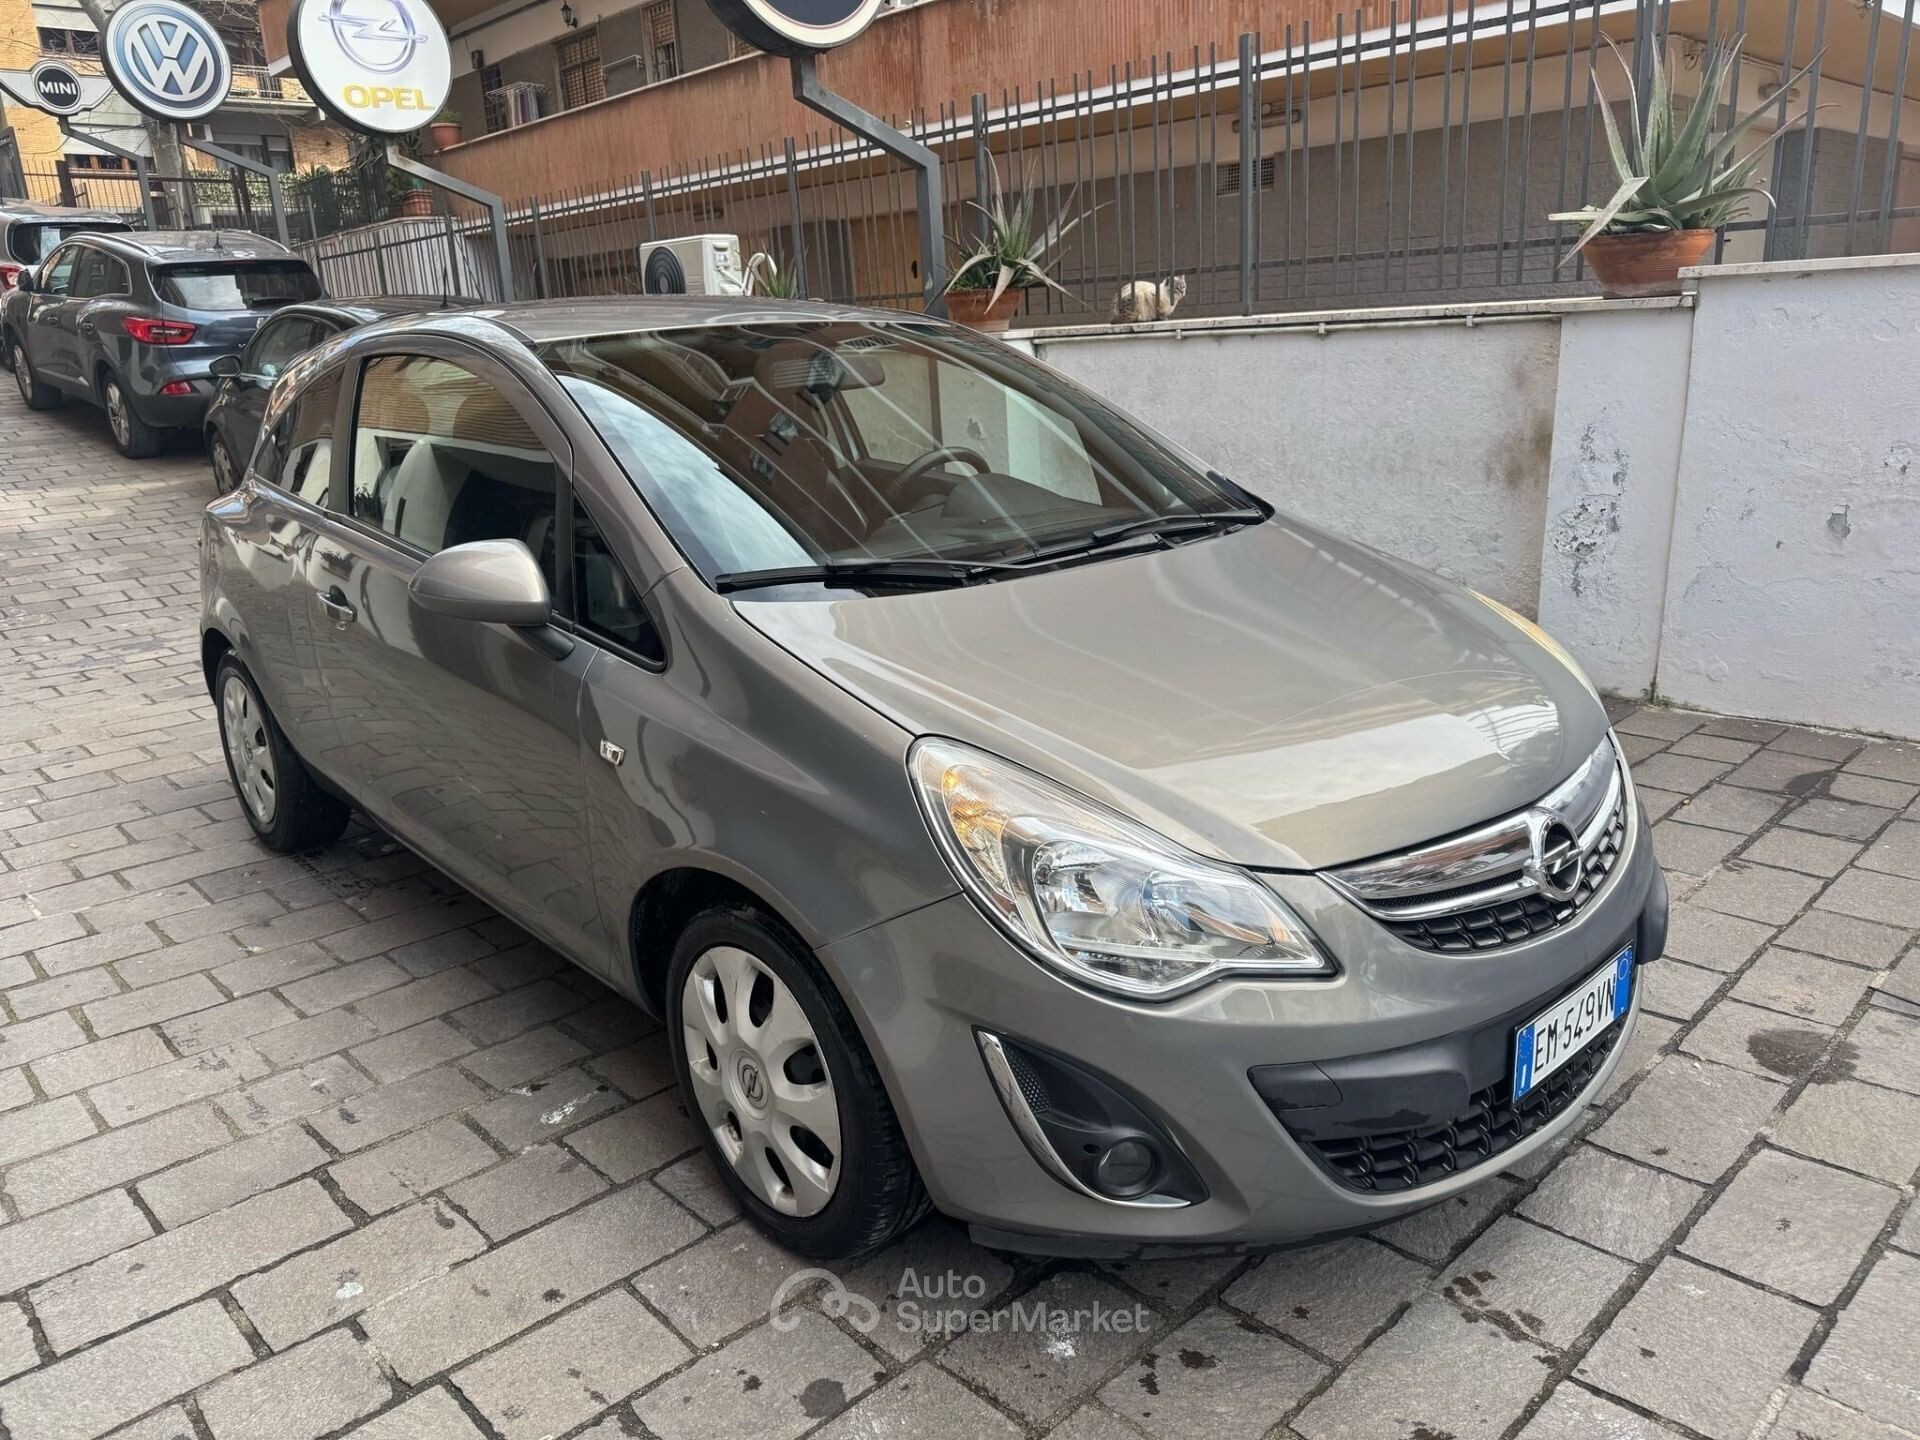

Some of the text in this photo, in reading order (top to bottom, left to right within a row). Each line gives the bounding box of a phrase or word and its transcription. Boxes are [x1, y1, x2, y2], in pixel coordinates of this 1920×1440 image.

[39, 81, 77, 95] MINI
[343, 84, 436, 110] OPEL
[1534, 973, 1617, 1073] EM 549VN
